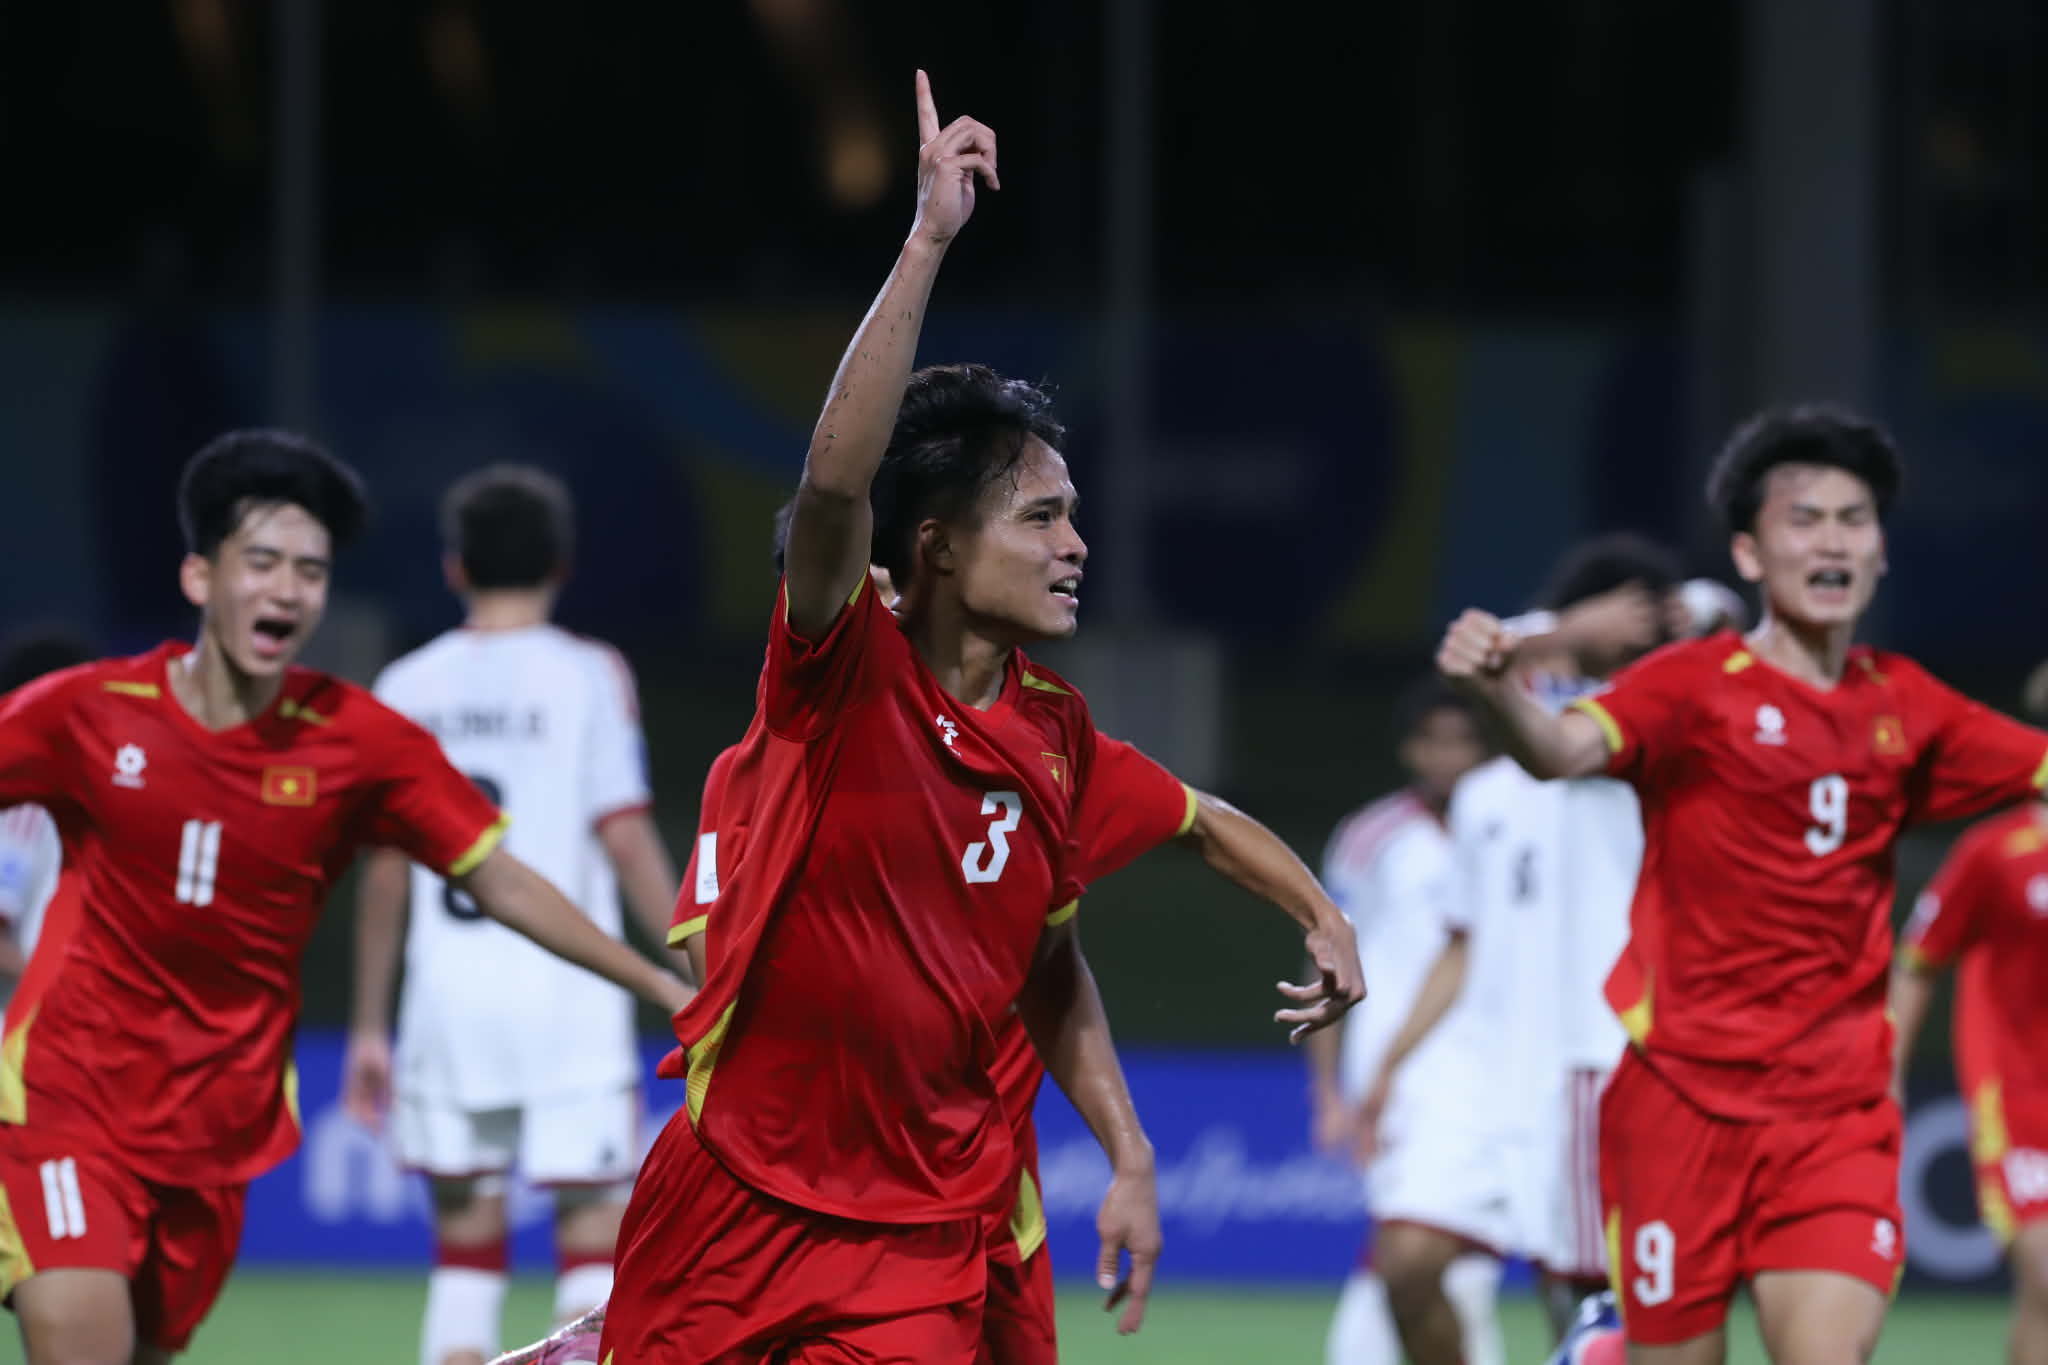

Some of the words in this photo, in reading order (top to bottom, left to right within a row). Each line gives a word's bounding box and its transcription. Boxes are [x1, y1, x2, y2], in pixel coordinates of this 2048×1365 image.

[961, 791, 1023, 884] 3
[1805, 774, 1848, 857] 9
[175, 819, 223, 907] 11
[40, 1157, 87, 1240] 11
[1633, 1220, 1675, 1307] 9
